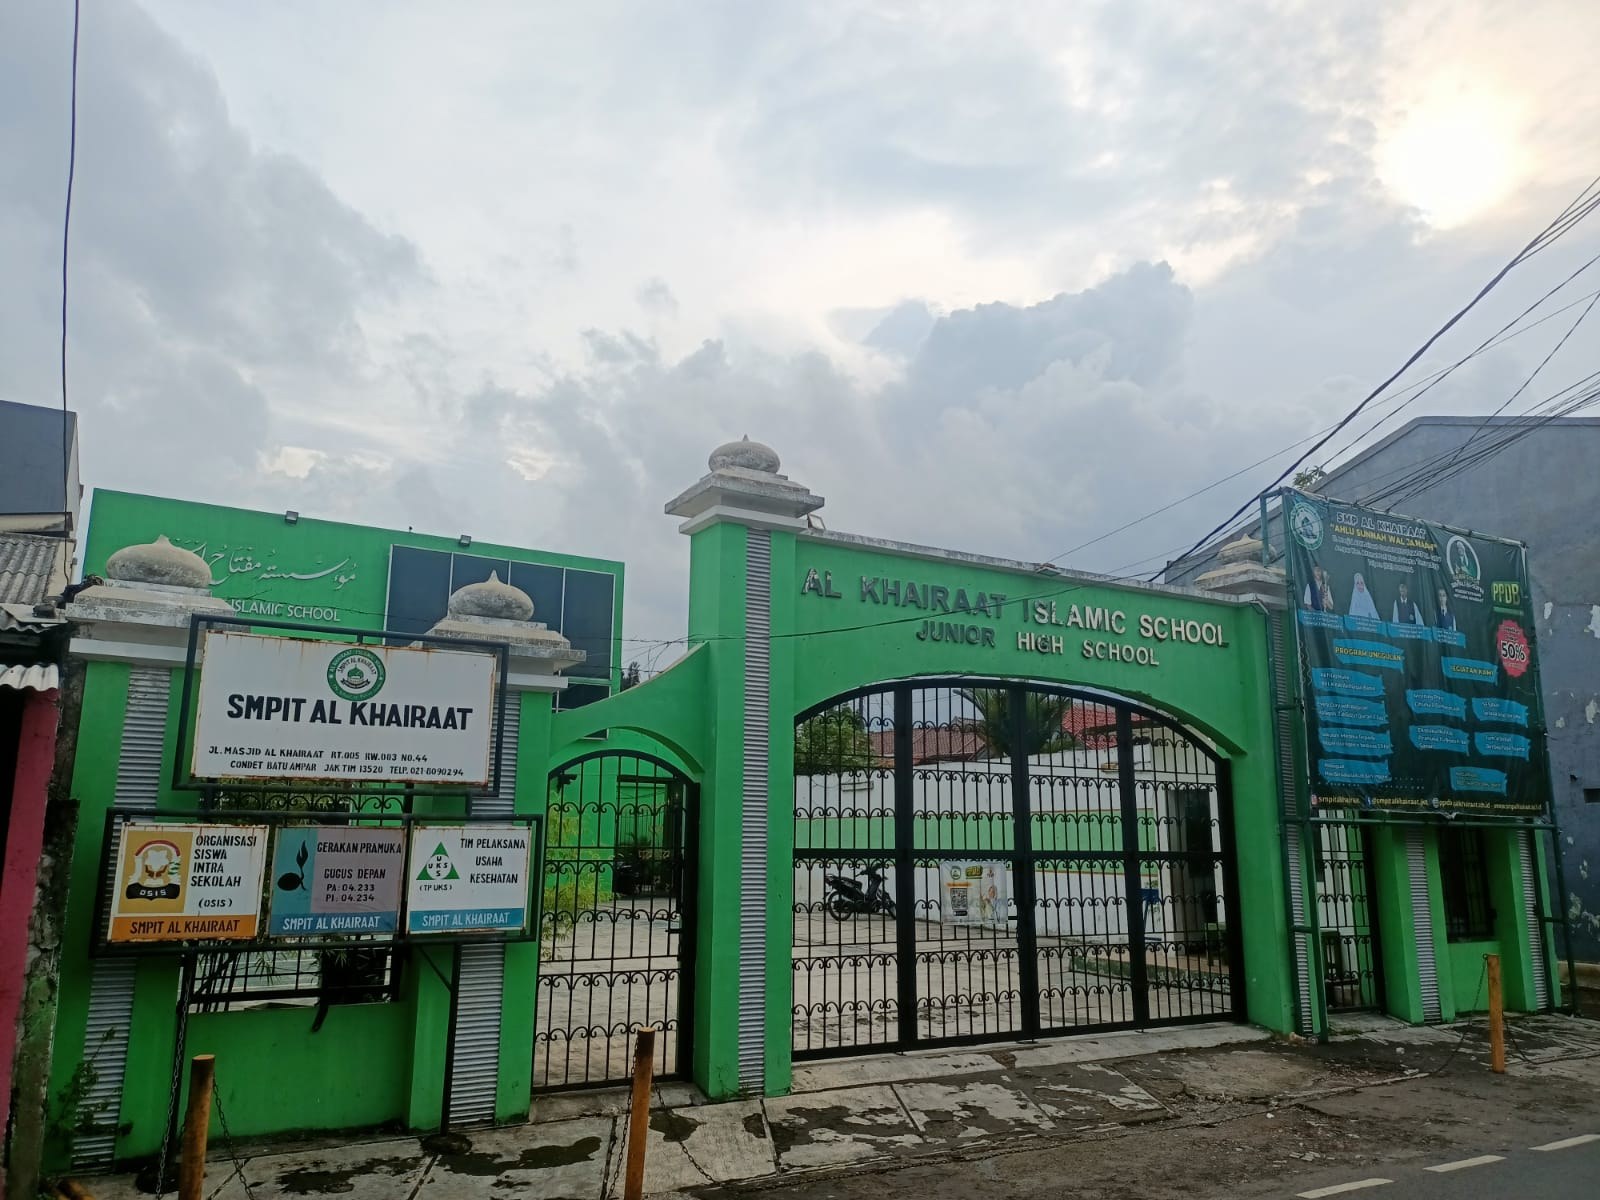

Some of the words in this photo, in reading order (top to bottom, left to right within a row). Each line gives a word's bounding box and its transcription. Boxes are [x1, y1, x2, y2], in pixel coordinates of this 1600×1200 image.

[1361, 516, 1375, 529] AL
[1493, 582, 1521, 607] PPDB
[231, 599, 285, 617] ISLAMIC
[287, 605, 341, 622] SCHOOL
[801, 567, 842, 598] AL
[859, 574, 1007, 620] KHAIRAAT
[1022, 599, 1127, 634] ISLAMIC
[1138, 613, 1230, 648] SCHOOL
[916, 619, 997, 648] JUNIOR
[1016, 631, 1064, 655] HIGH
[1082, 638, 1160, 667] SCHOOL
[1501, 640, 1527, 662] 50%
[226, 694, 306, 722] SMPIT
[309, 699, 342, 725] AL
[349, 701, 473, 731] KHAIRAAT
[224, 746, 261, 756] MASJID
[264, 748, 277, 757] AL
[279, 748, 324, 759] KHAIRAAT
[230, 760, 263, 770] CONDET
[266, 761, 288, 771] BATU
[289, 762, 317, 772] AMPAR
[359, 765, 383, 774] 13520
[195, 835, 257, 847] ORGANISASI
[460, 838, 474, 849] TIM
[476, 838, 525, 849] PELAKSANA
[193, 849, 227, 860] SISWA
[317, 842, 358, 853] GERAKAN
[359, 842, 402, 854] PRAMUKA
[193, 862, 224, 873] INTRA
[475, 856, 503, 867] USAHA
[323, 868, 353, 879] GUGUS
[357, 868, 386, 879] DEPAN
[469, 873, 518, 884] KESEHATAN
[190, 876, 242, 887] SEKOLAH
[139, 889, 167, 897] OSIS
[282, 917, 313, 930] SMPIT
[315, 917, 328, 930] AL
[330, 915, 381, 929] KHAIRAAT
[422, 914, 449, 927] SMPIT
[452, 914, 463, 926] AL
[465, 911, 511, 925] KHAIRAAT
[129, 921, 165, 934] SMPIT
[167, 920, 181, 934] AL
[184, 919, 240, 933] KHAIRAAT
